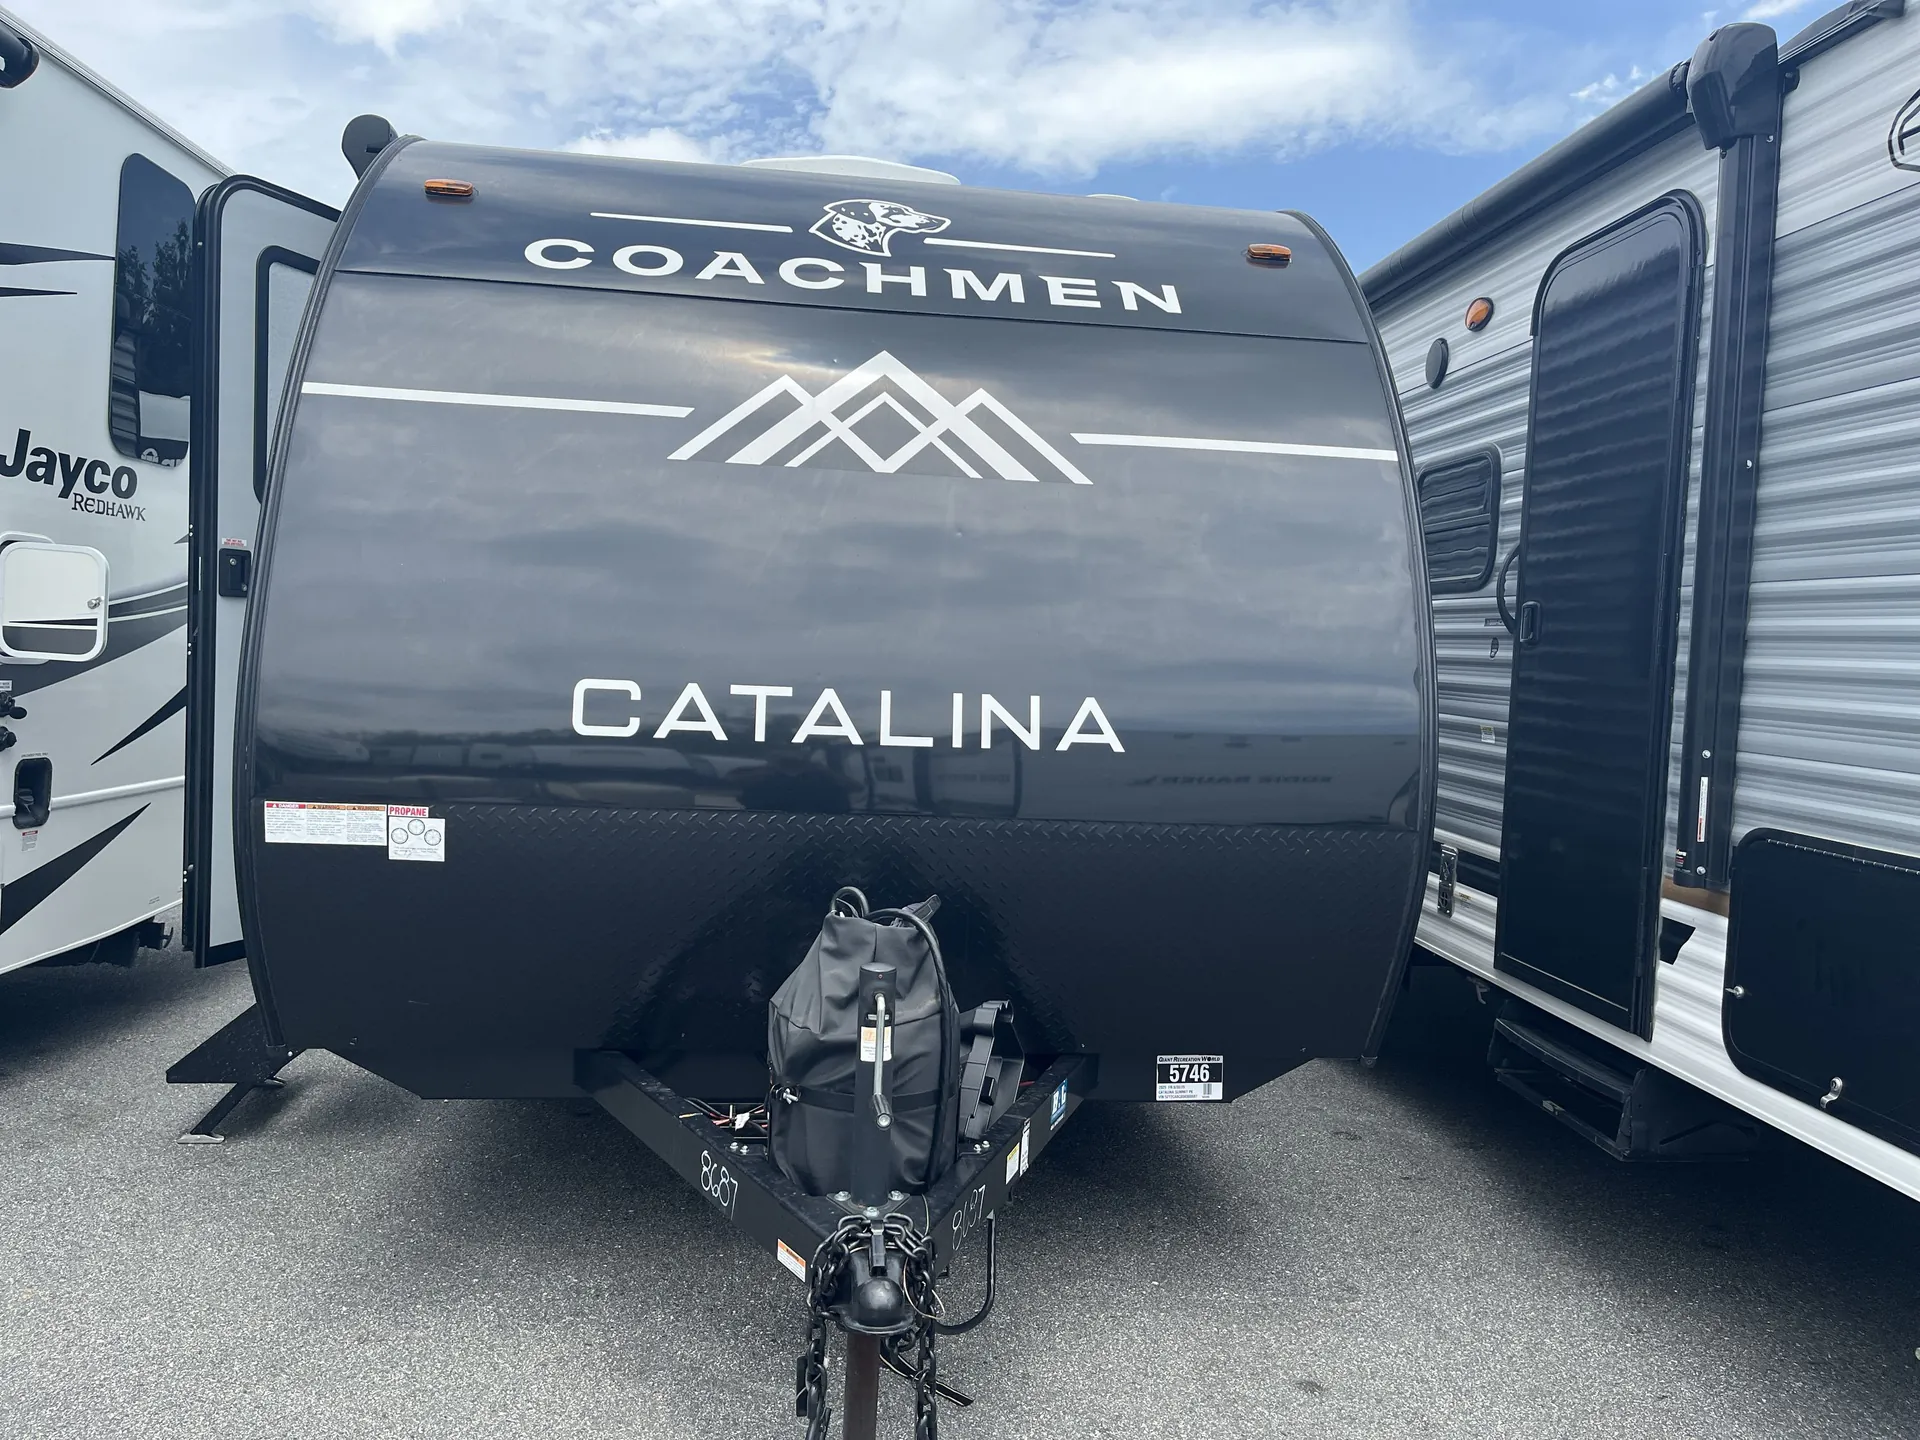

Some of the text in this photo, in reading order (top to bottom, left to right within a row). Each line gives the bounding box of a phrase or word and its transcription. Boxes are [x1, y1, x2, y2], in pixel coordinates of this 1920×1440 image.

[524, 238, 1182, 314] COACHMEN
[0, 428, 138, 500] Jayco
[71, 492, 146, 522] REDHAWK
[572, 678, 1126, 753] CATALINA
[388, 806, 427, 817] PROPANE
[1169, 1063, 1210, 1083] 5746
[701, 1150, 738, 1221] 8687
